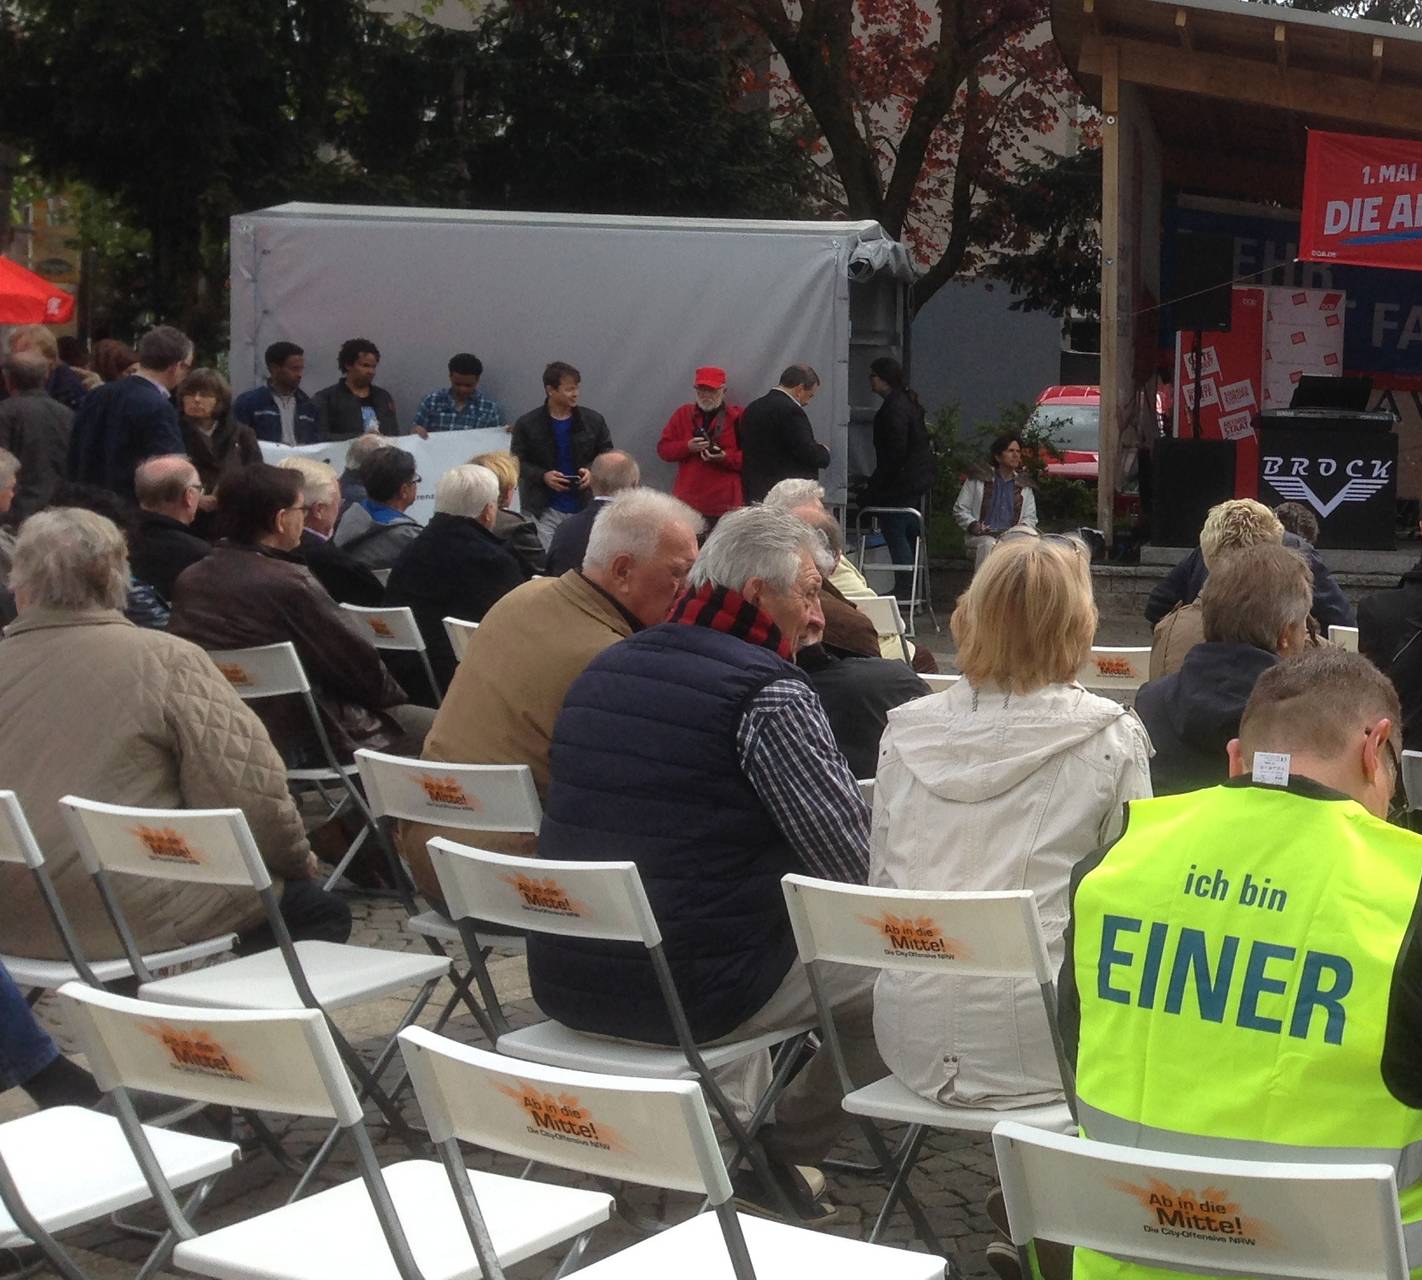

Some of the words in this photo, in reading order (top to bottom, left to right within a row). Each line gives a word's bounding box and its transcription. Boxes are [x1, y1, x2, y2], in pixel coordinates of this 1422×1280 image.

[1362, 165, 1375, 184] 1.
[1379, 164, 1417, 184] MAI
[1324, 196, 1384, 235] DIE
[1262, 456, 1393, 478] BROCK
[1183, 864, 1230, 901] ich
[1238, 874, 1288, 912] bin
[885, 924, 900, 934] Ab
[903, 926, 913, 935] in
[916, 928, 933, 936] die
[890, 934, 946, 952] Mitte!
[1097, 914, 1354, 1046] EINER
[523, 1096, 542, 1110] Ab
[545, 1104, 557, 1114] in
[560, 1105, 581, 1119] die
[531, 1110, 599, 1140] Mitte!
[1149, 1192, 1173, 1208] Ab
[1178, 1197, 1194, 1210] in
[1200, 1200, 1226, 1214] die
[1156, 1207, 1243, 1235] Mitte!
[1143, 1225, 1159, 1233] Die
[1229, 1236, 1256, 1246] NRW
